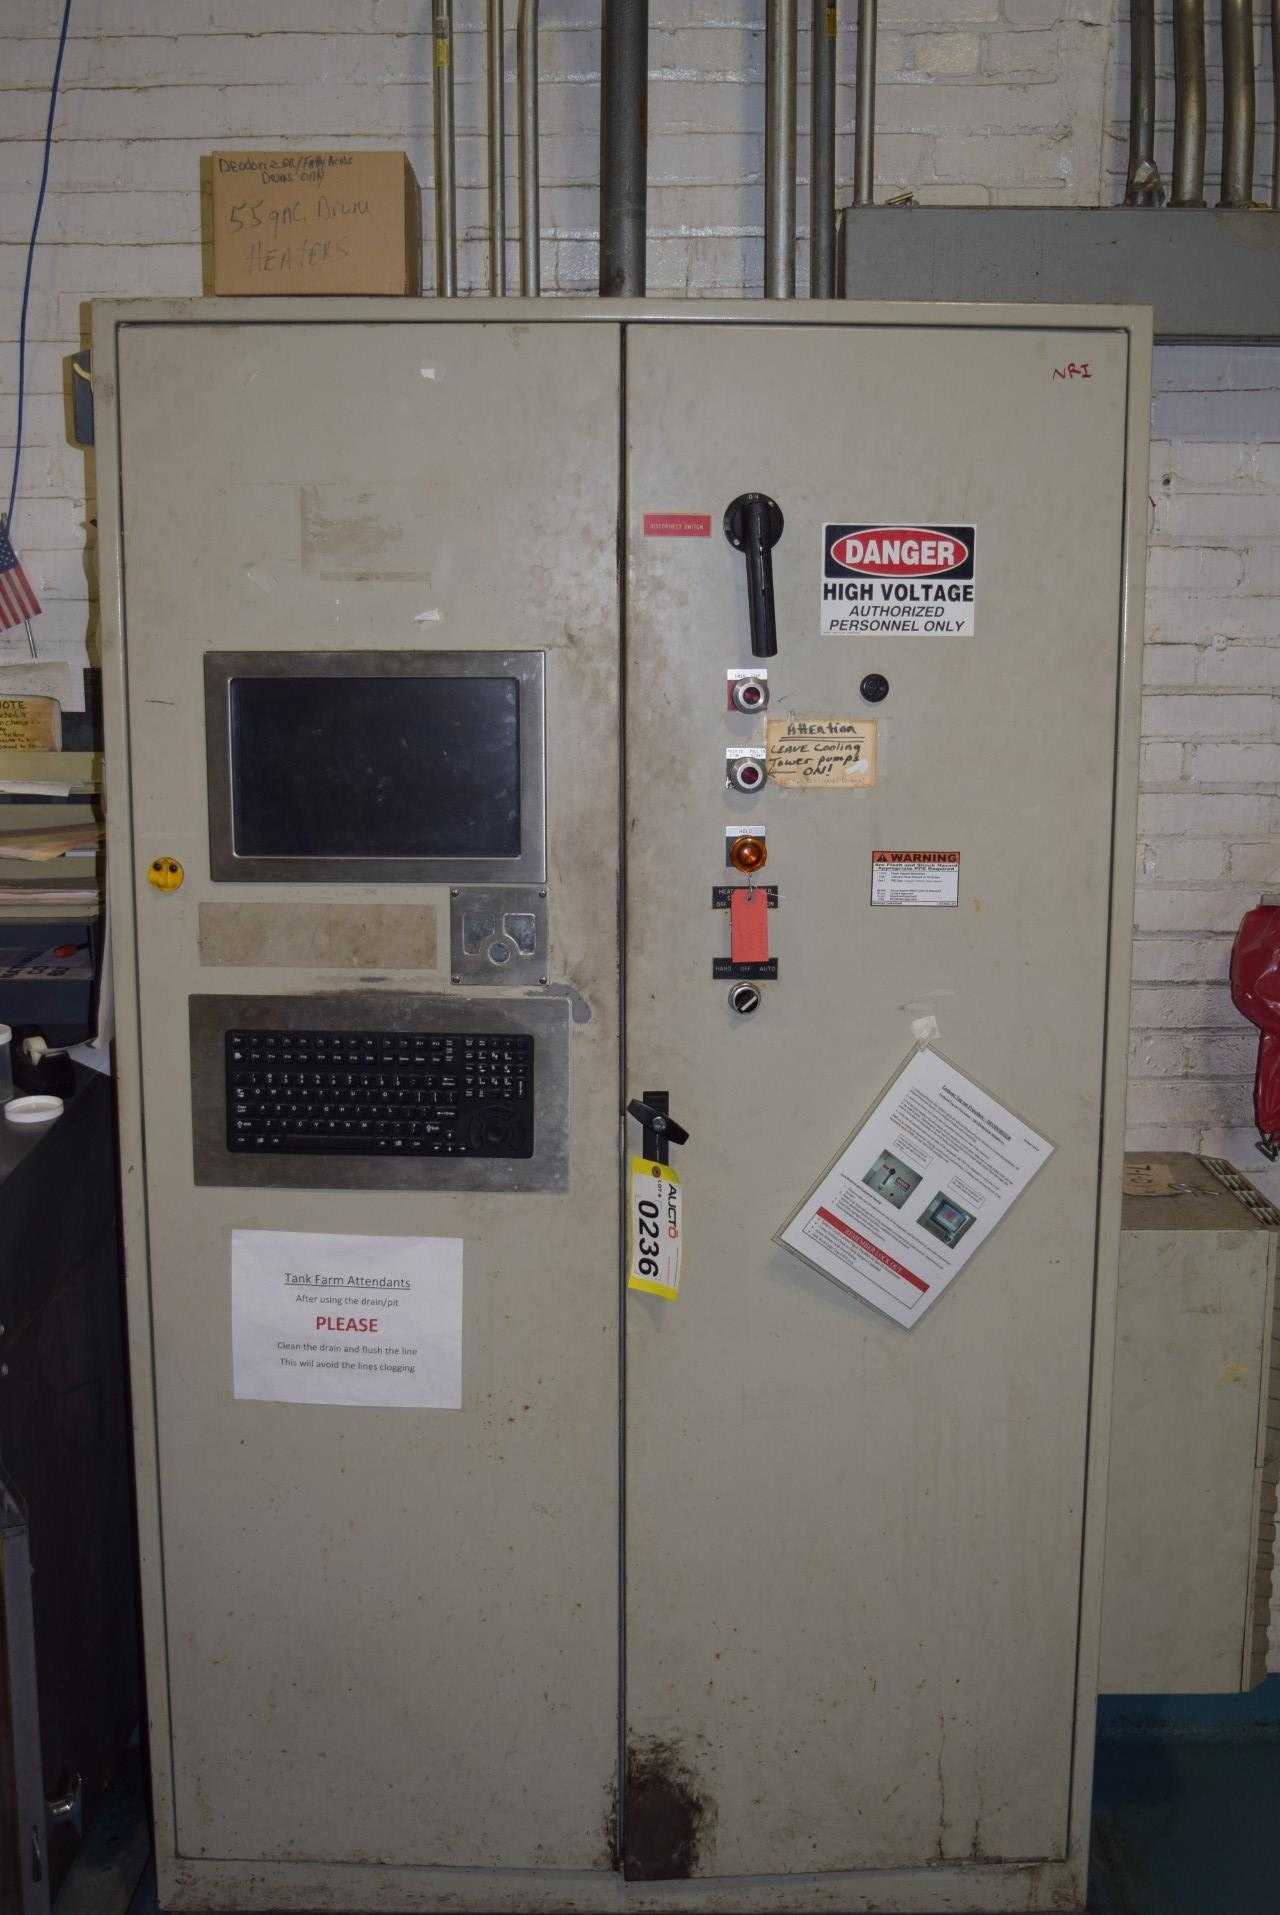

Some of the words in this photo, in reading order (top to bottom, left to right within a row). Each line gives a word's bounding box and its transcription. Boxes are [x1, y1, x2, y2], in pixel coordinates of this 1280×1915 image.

[229, 199, 264, 233] 55
[845, 539, 955, 566] DANGER
[823, 583, 873, 601] HIGH
[881, 584, 974, 602] VOLTAGE
[848, 605, 945, 617] AUTHORIZED
[829, 620, 920, 632] PERSONNEL
[923, 620, 965, 632] ONLY
[814, 743, 861, 753] Cooling
[818, 755, 860, 766] pumps
[803, 764, 833, 776] ON!
[891, 853, 957, 862] WARNING
[638, 1200, 660, 1277] 0236
[285, 1272, 311, 1285] Tank
[315, 1274, 344, 1286] Farm
[347, 1275, 411, 1288] Attendants
[296, 1295, 318, 1303] After
[320, 1296, 342, 1306] using
[345, 1297, 359, 1305] the
[361, 1297, 399, 1308] drain/pit
[316, 1316, 378, 1333] PLEASE
[277, 1342, 301, 1350] Clean
[303, 1342, 318, 1351] the
[319, 1343, 342, 1352] drain
[344, 1345, 359, 1353] and
[362, 1345, 383, 1354] flush
[384, 1346, 400, 1355] the
[402, 1347, 418, 1355] line
[280, 1357, 297, 1367] This
[299, 1358, 314, 1367] will
[316, 1360, 339, 1369] avoid
[341, 1361, 356, 1370] the
[357, 1362, 377, 1371] lines
[379, 1363, 416, 1374] clogging
